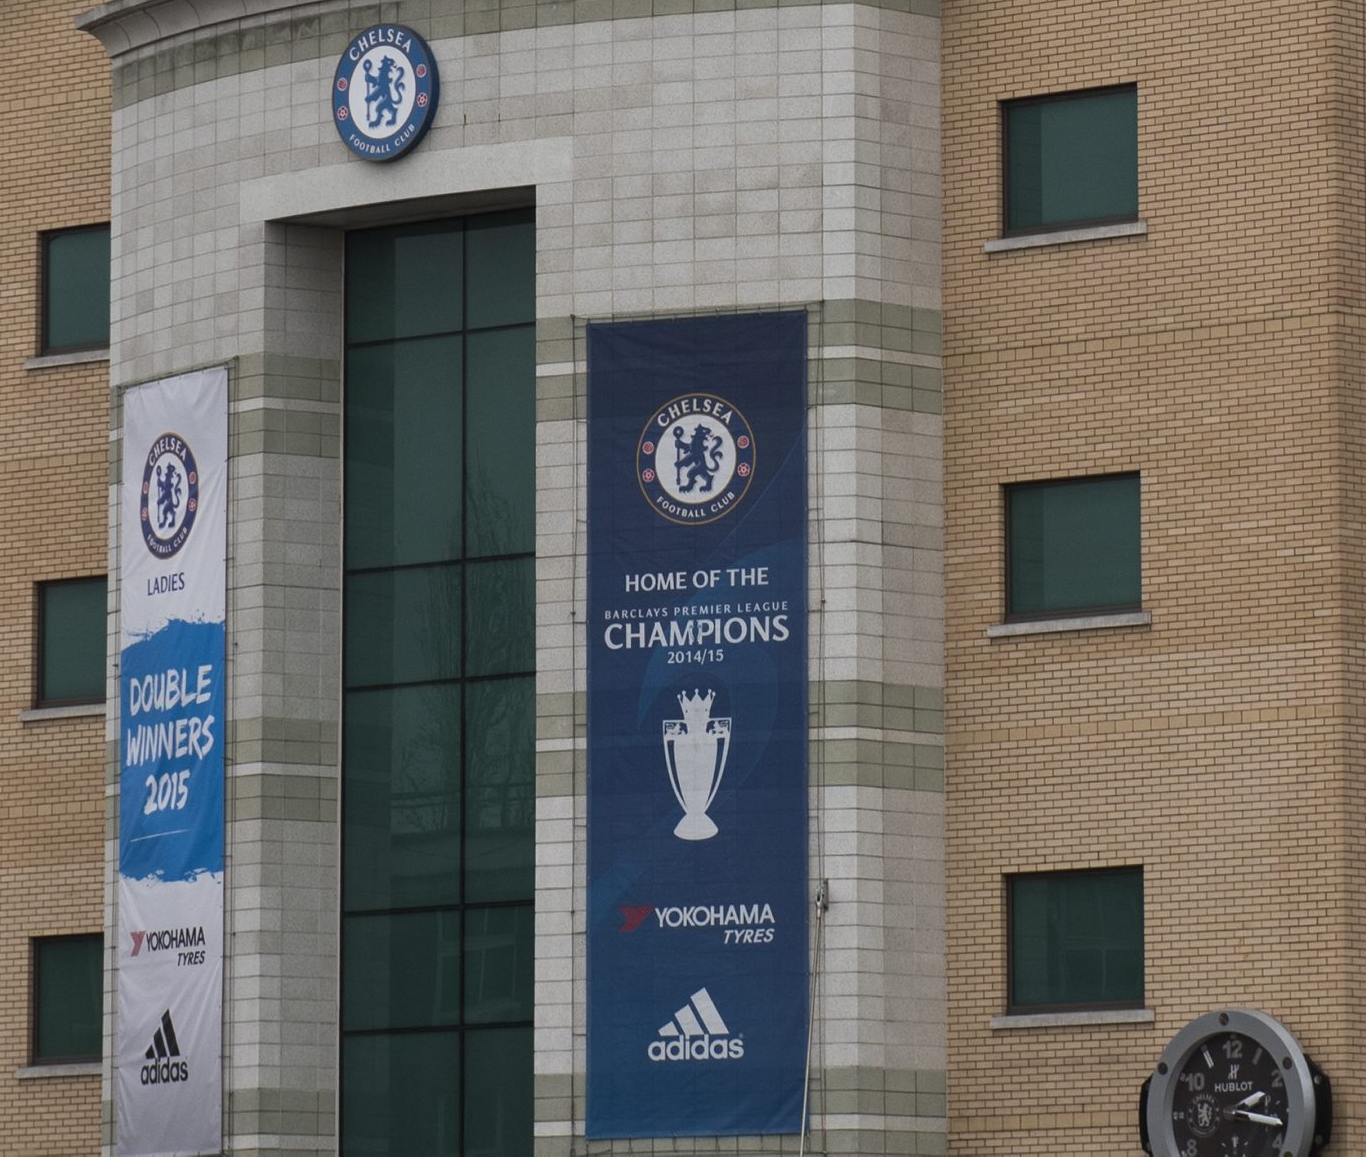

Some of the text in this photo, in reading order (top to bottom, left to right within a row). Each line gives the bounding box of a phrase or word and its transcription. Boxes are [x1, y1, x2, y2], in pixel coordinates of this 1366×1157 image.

[349, 28, 412, 61] CHELSEA
[349, 123, 415, 154] FOOTBALL CLUB
[656, 398, 733, 428] CHELSEA
[148, 436, 187, 467] CHELSEA
[656, 490, 736, 518] FOOTBALL CLUB
[173, 527, 188, 549] CLUB
[147, 571, 186, 596] LADIES
[624, 567, 769, 592] HOME OF THE
[604, 600, 789, 620] BARCLAYS PREMIER LEAGUE
[603, 614, 790, 650] CHAMPIONS
[667, 648, 724, 666] 2014/15
[129, 664, 213, 717] DOUBLE
[126, 715, 216, 767] WINNERS
[143, 769, 191, 816] 2015
[654, 903, 776, 929] YOKOHAMA
[146, 926, 206, 952] YOKOHAMA
[723, 928, 775, 945] TYRES
[177, 950, 206, 967] TYRES
[647, 1034, 744, 1062] adidas
[1222, 1040, 1243, 1059] 12
[141, 1058, 188, 1085] adidas
[1187, 1072, 1205, 1092] 10
[1214, 1081, 1254, 1092] HUBLOT
[1186, 1139, 1197, 1157] 8
